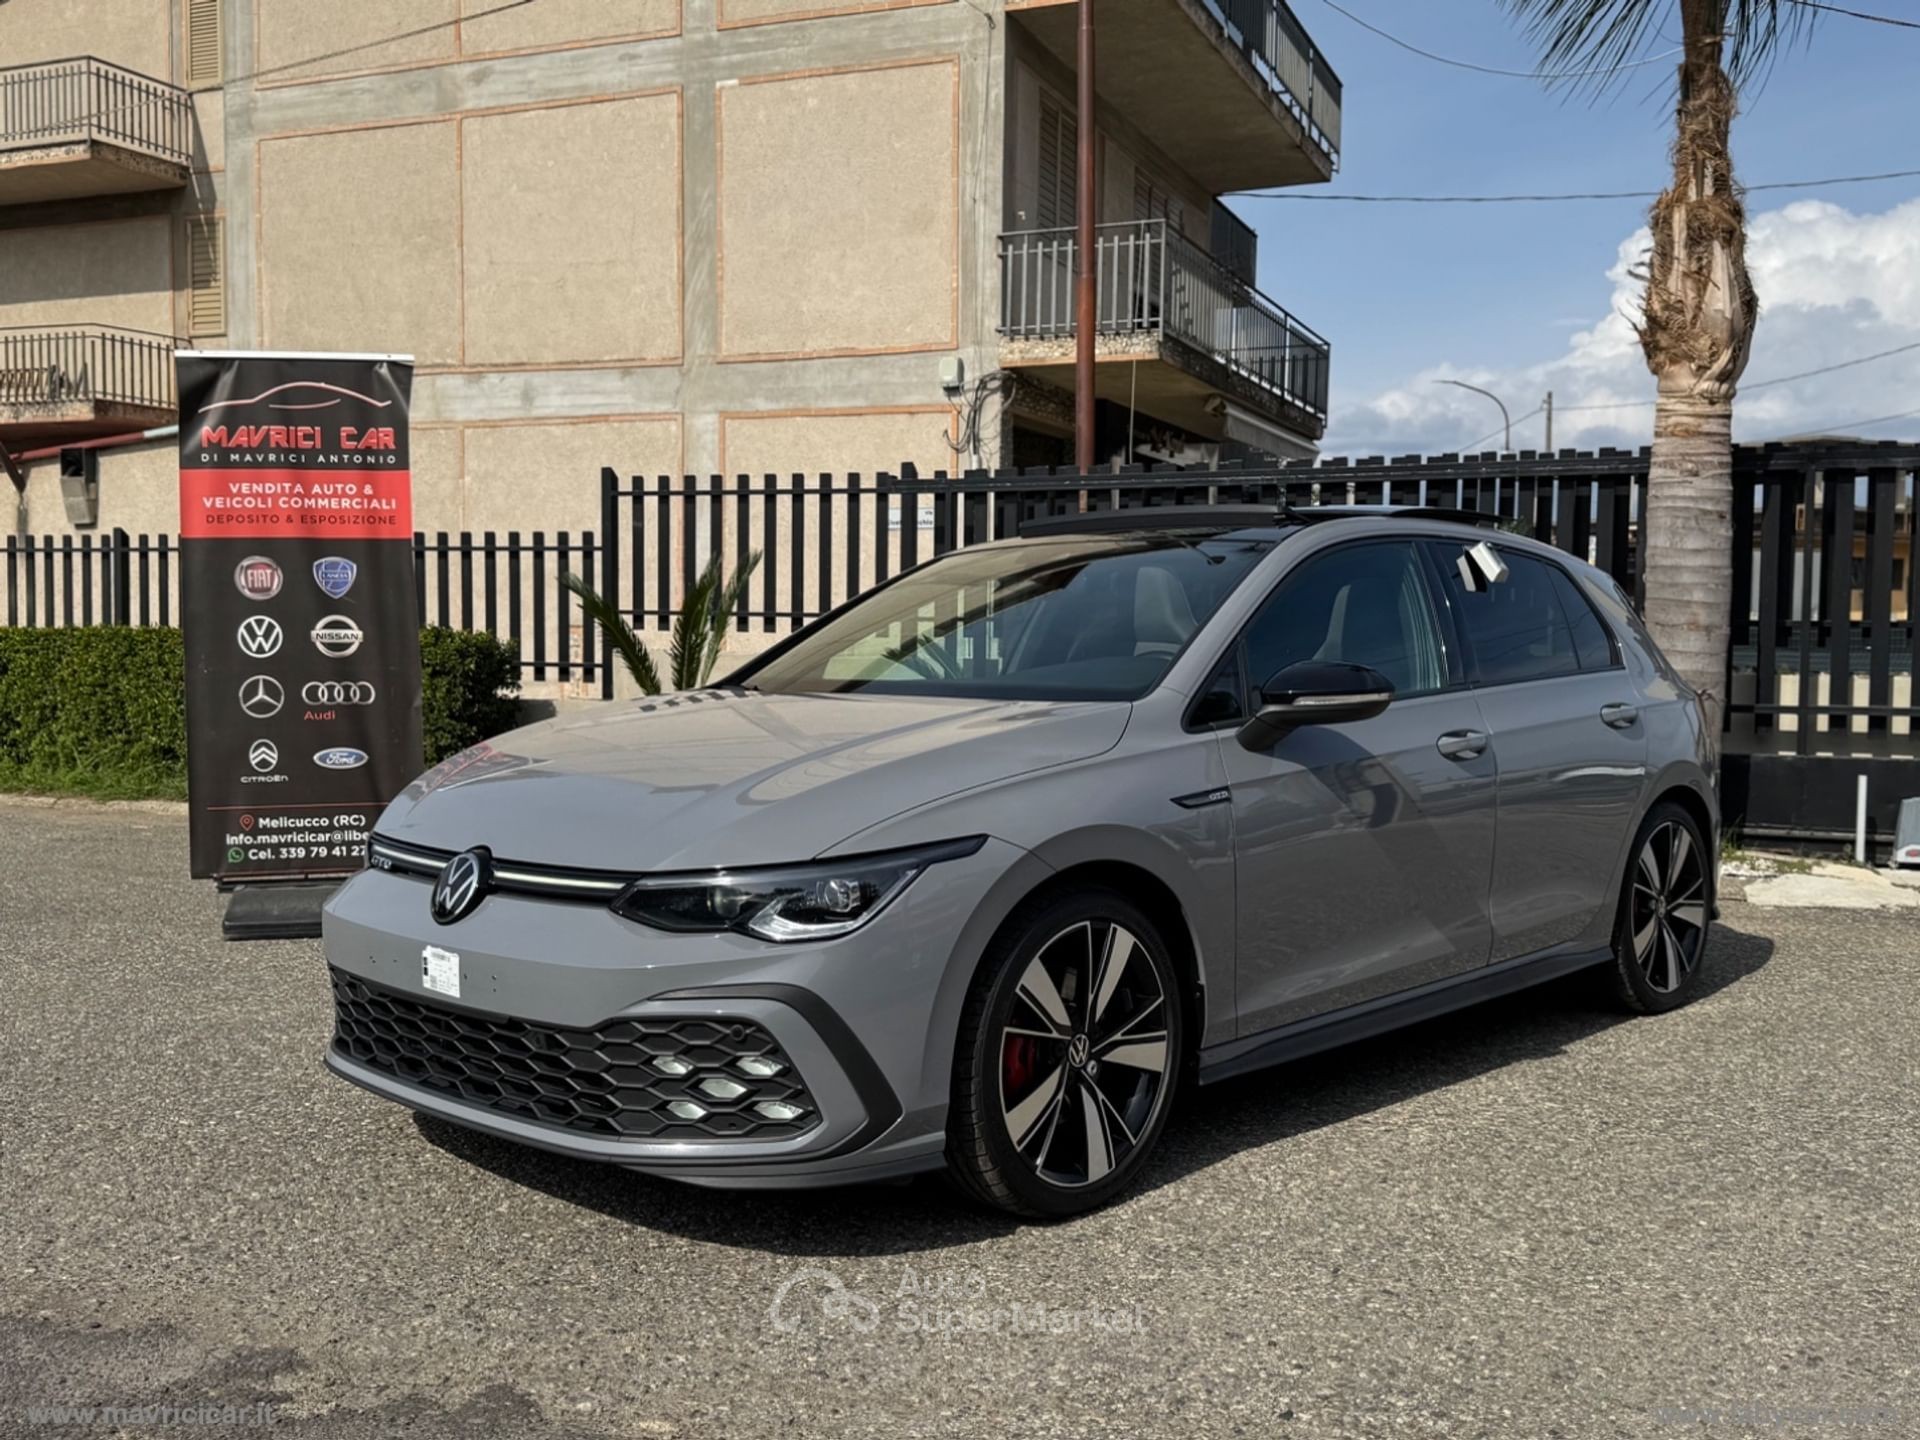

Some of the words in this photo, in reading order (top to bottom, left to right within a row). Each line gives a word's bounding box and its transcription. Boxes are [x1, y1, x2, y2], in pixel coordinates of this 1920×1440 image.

[201, 425, 322, 449] MAVRICI
[340, 427, 396, 450] CAR
[201, 453, 218, 462] DI
[230, 453, 306, 463] MAVRICI
[317, 454, 396, 464] ANTONIO
[229, 482, 305, 494] VENDITA
[311, 483, 357, 495] AUTO
[363, 484, 374, 495] &
[202, 497, 272, 509] VEICOLI
[278, 498, 396, 510] COMMERCIALI
[206, 514, 280, 524] DEPOSITO
[286, 515, 294, 524] &
[301, 515, 396, 526] ESPOSIZIONE
[247, 569, 273, 589] FIAT
[315, 632, 359, 640] NISSAN
[304, 710, 336, 721] Audi
[326, 751, 356, 764] Ford
[258, 816, 330, 829] Melicucco
[333, 814, 366, 828] (RC)
[248, 848, 276, 860] Cel.
[279, 847, 306, 859] 339
[310, 846, 328, 858] 79
[331, 845, 347, 857] 41
